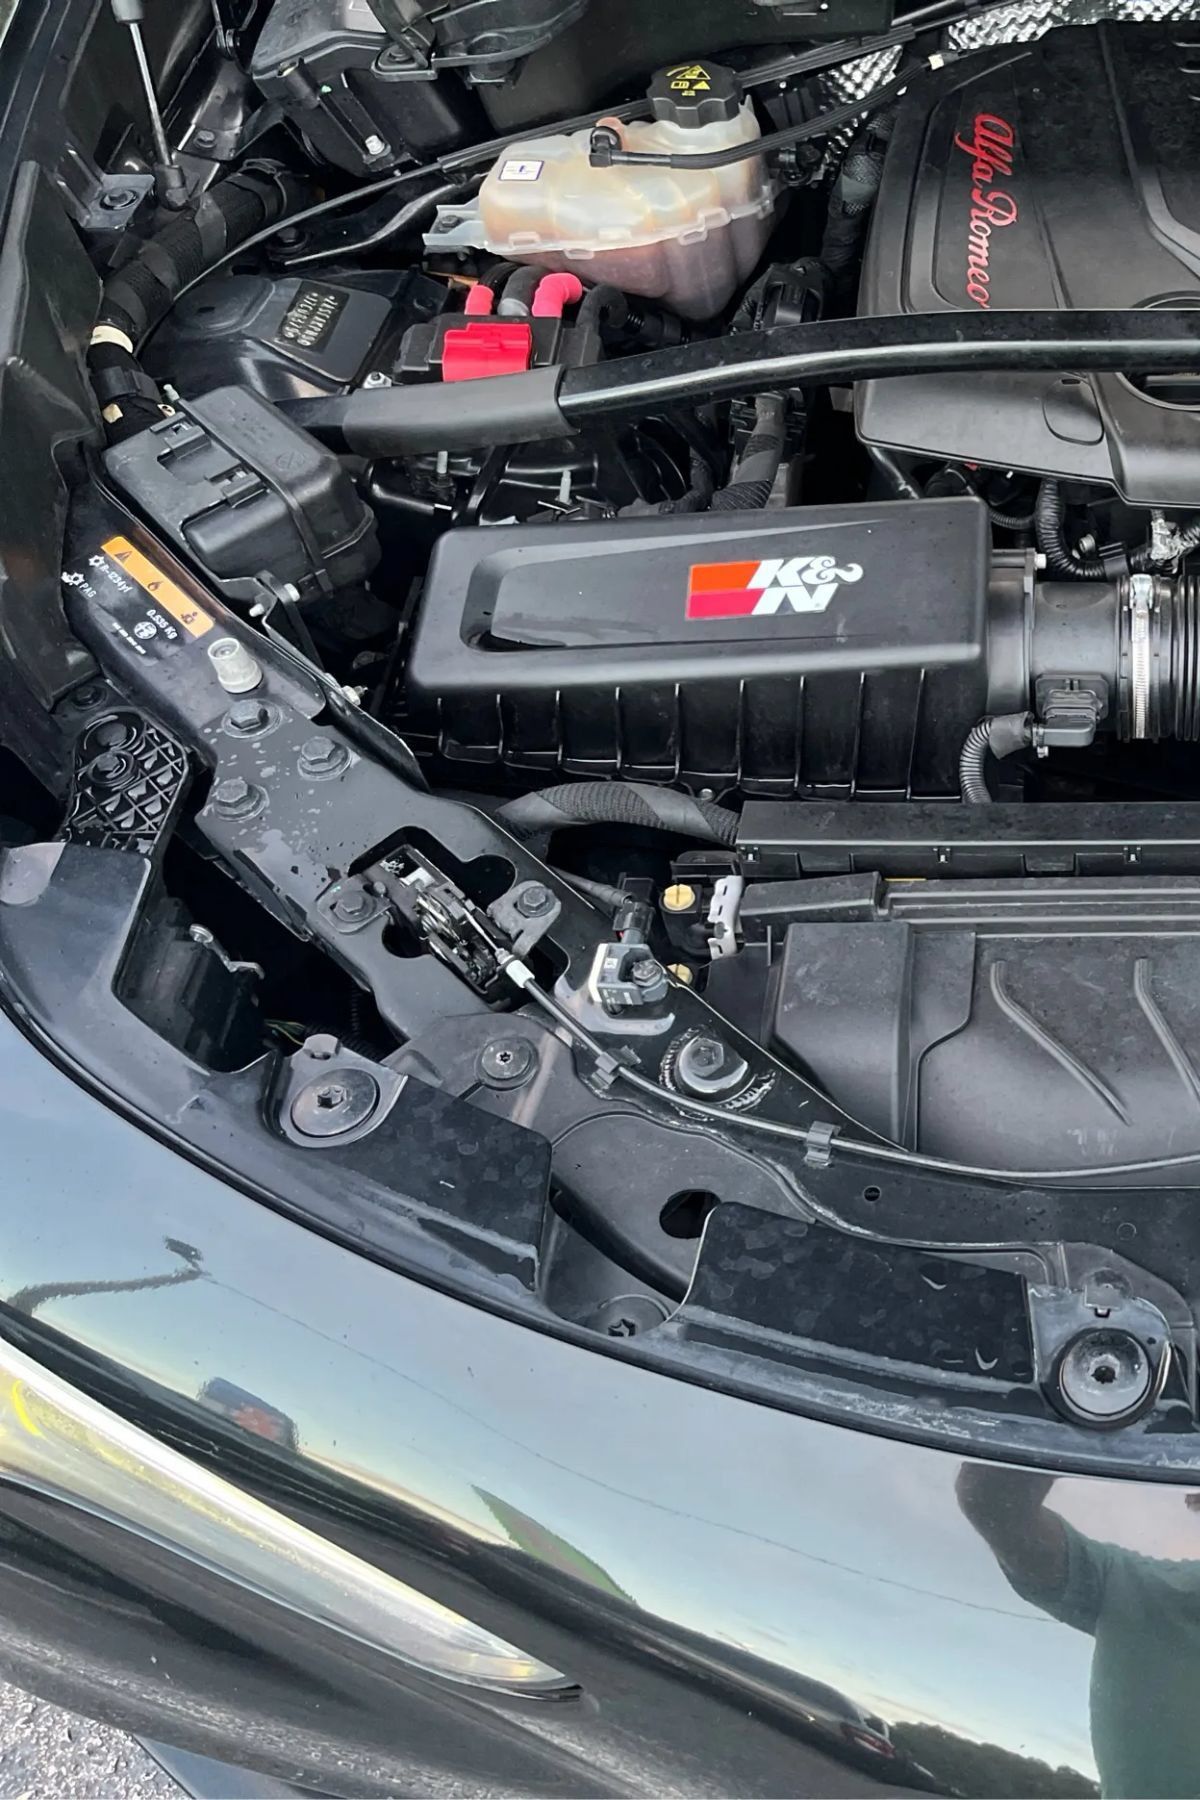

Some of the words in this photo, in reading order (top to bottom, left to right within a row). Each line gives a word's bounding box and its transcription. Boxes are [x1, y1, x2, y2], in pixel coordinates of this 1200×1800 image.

[954, 112, 1014, 189] Alfa
[966, 187, 1018, 309] Romeo
[78, 581, 97, 598] PAG
[745, 555, 864, 616] K&N
[163, 625, 178, 640] Kg
